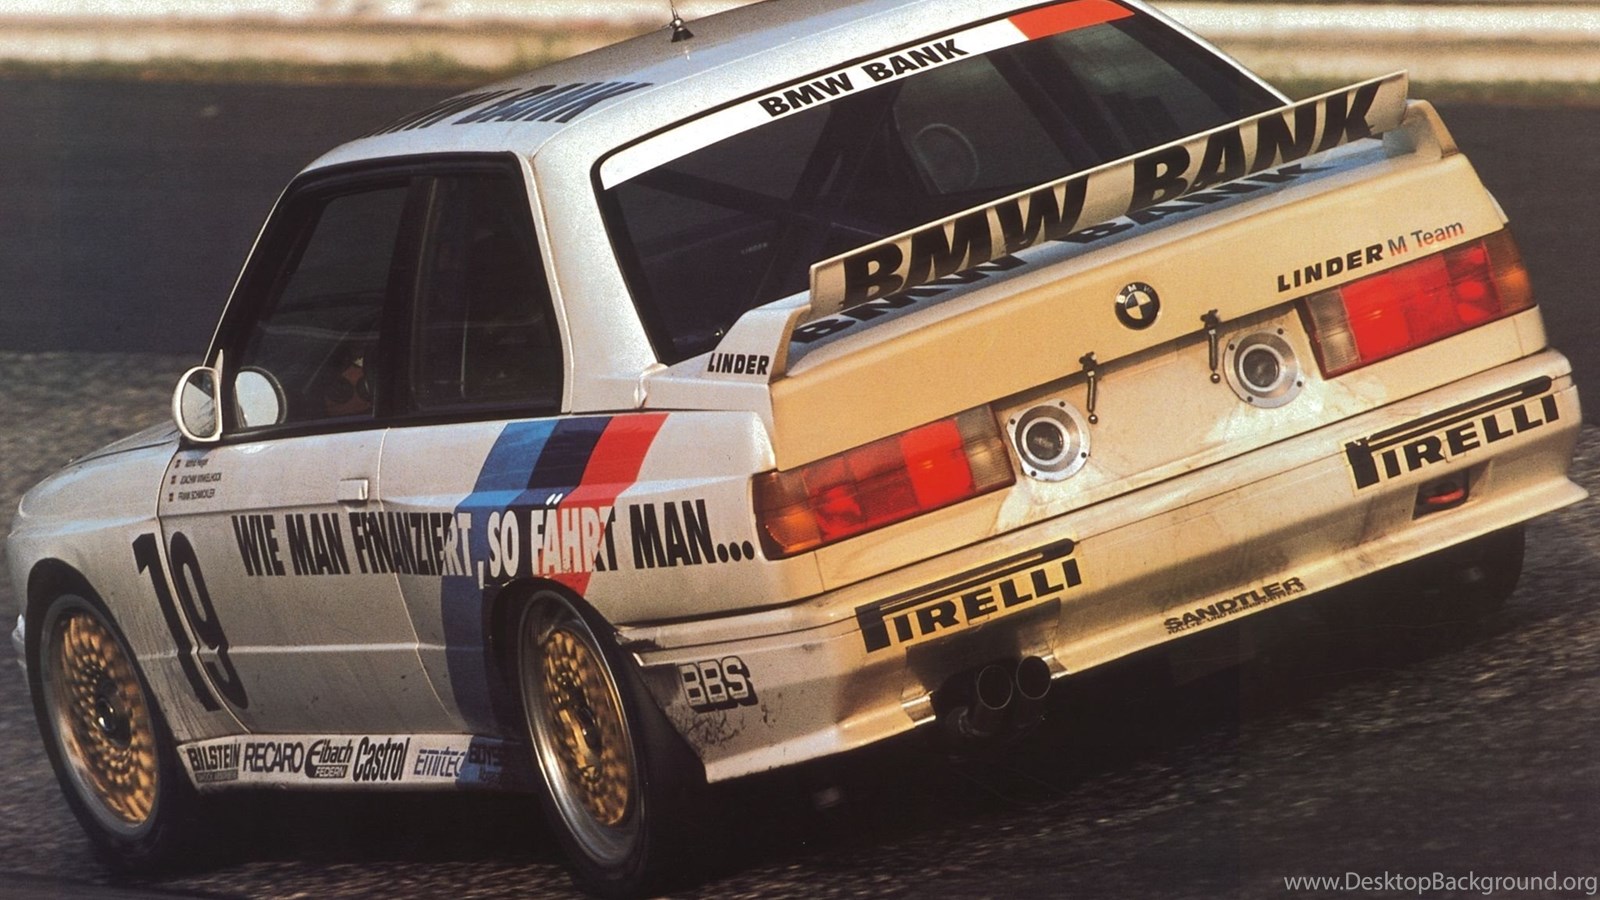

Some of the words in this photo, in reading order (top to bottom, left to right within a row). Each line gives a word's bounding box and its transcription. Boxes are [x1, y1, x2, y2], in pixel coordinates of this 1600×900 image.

[758, 72, 855, 117] BMW
[861, 38, 970, 82] BANK
[841, 174, 1089, 310] BMW
[1128, 80, 1384, 213] BANK
[1277, 243, 1384, 293] LINDER
[1387, 235, 1409, 257] M
[1410, 221, 1465, 248] Team
[707, 352, 770, 376] LINDER
[1345, 375, 1560, 490] PIRELLI
[231, 514, 286, 576] WIE
[285, 513, 350, 575] MAN
[487, 510, 520, 578] SO
[530, 493, 616, 574] FÄHRT
[629, 499, 755, 570] MAN...
[132, 531, 249, 712] 19
[854, 538, 1082, 654] PIRELLI
[1164, 577, 1305, 631] SANDTLER
[677, 655, 758, 714] BBS
[186, 743, 241, 771] BILSTEIN
[243, 742, 304, 773] RECARO
[353, 736, 411, 782] Castrol
